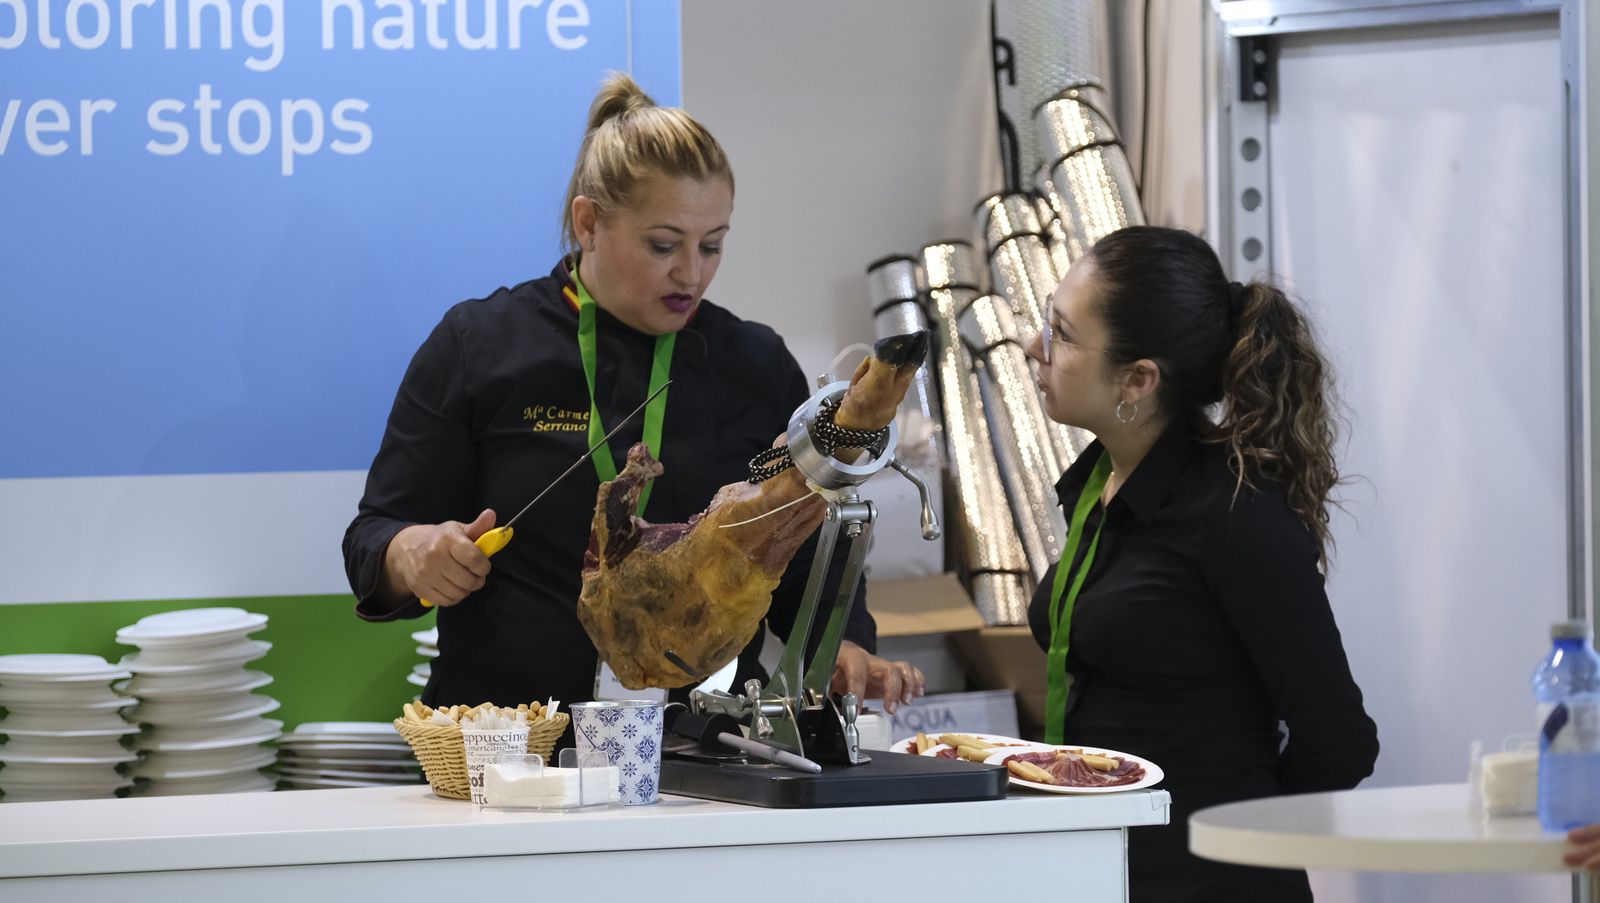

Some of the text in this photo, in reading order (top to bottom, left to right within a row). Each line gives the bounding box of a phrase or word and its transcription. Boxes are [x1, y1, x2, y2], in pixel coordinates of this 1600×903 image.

[320, 0, 590, 50] nature
[146, 84, 373, 176] stops
[533, 420, 587, 432] Serrano
